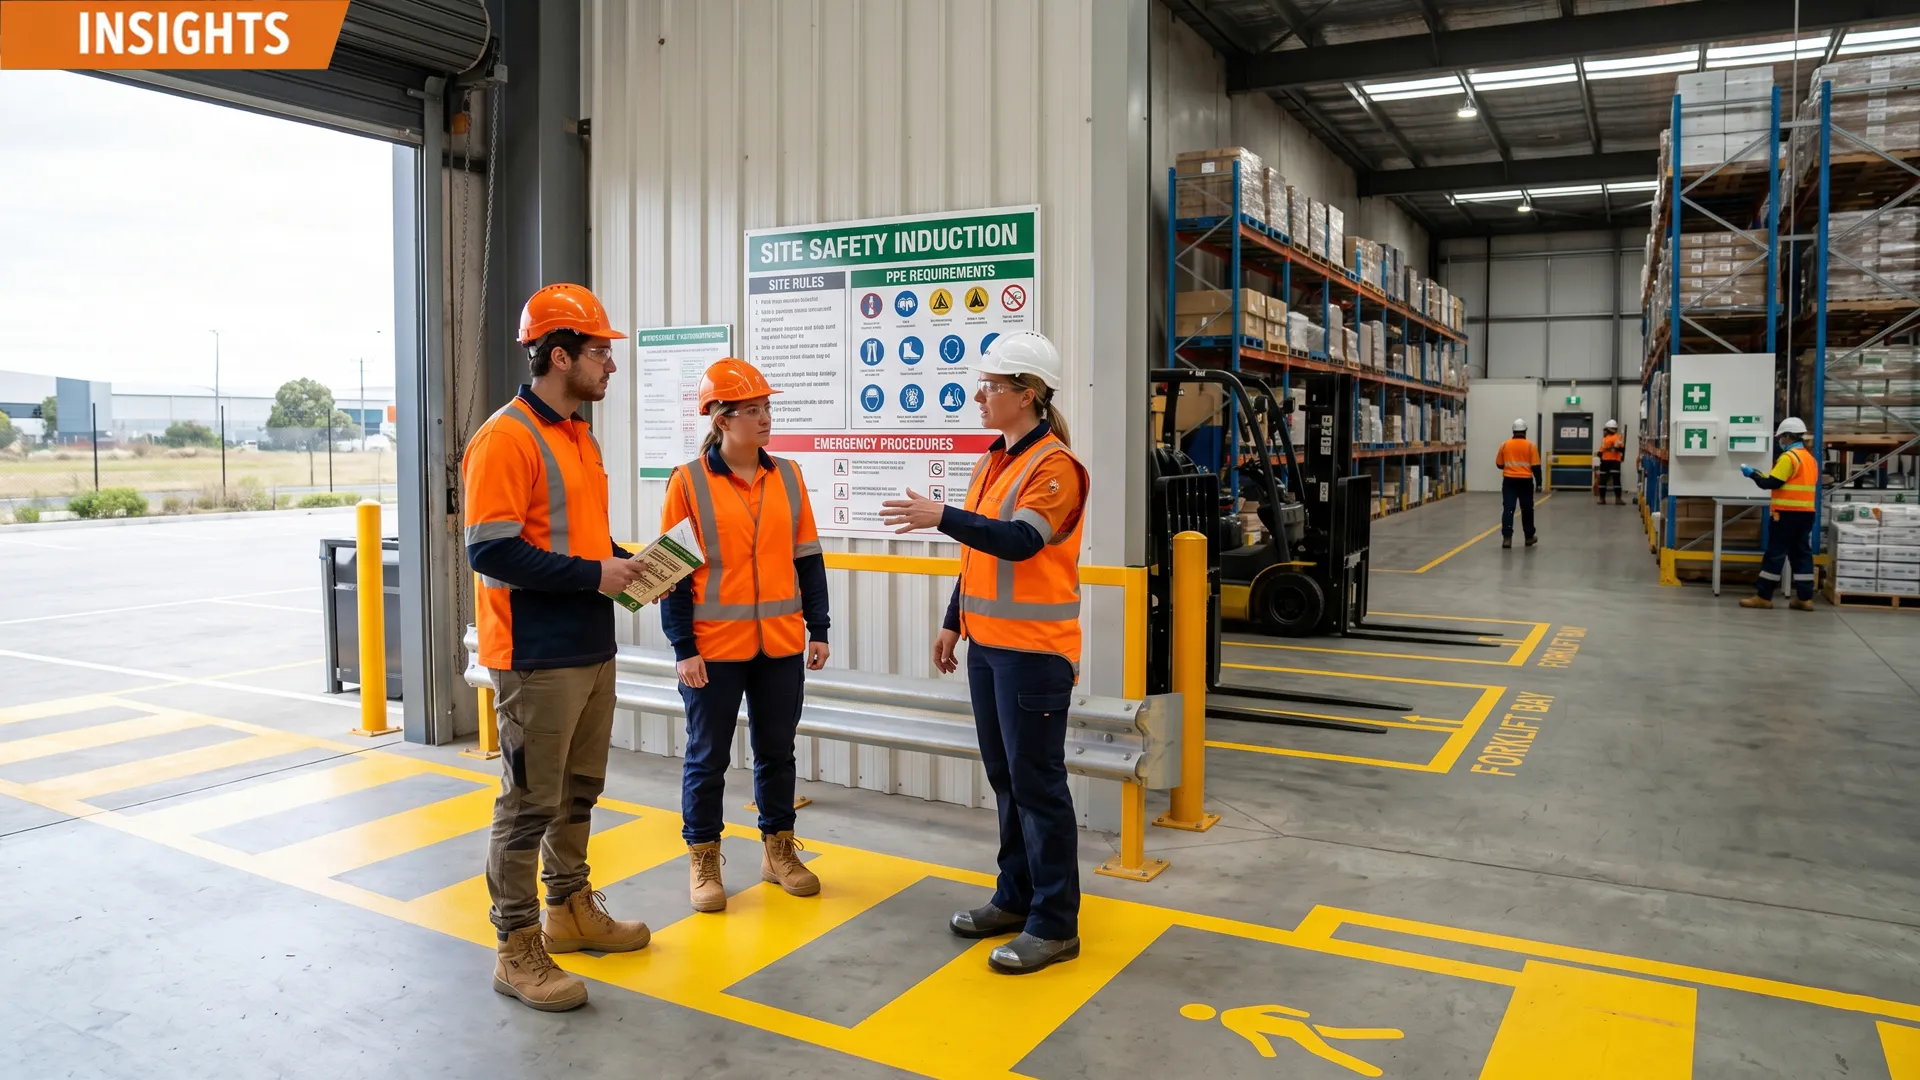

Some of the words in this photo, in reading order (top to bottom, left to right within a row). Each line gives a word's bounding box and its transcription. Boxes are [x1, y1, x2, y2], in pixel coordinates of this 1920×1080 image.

[760, 240, 803, 264] SITE
[809, 233, 888, 260] SAFETY
[894, 223, 1018, 253] INDUCTION
[886, 270, 906, 283] PPE
[909, 264, 996, 282] REQUIREMENTS
[768, 279, 790, 291] SITE
[793, 276, 825, 289] RULES
[814, 437, 877, 450] EMERGENCY
[880, 437, 954, 451] PROCEDURES
[1469, 712, 1543, 777] FORKLIFT
[1510, 690, 1556, 713] BAY
